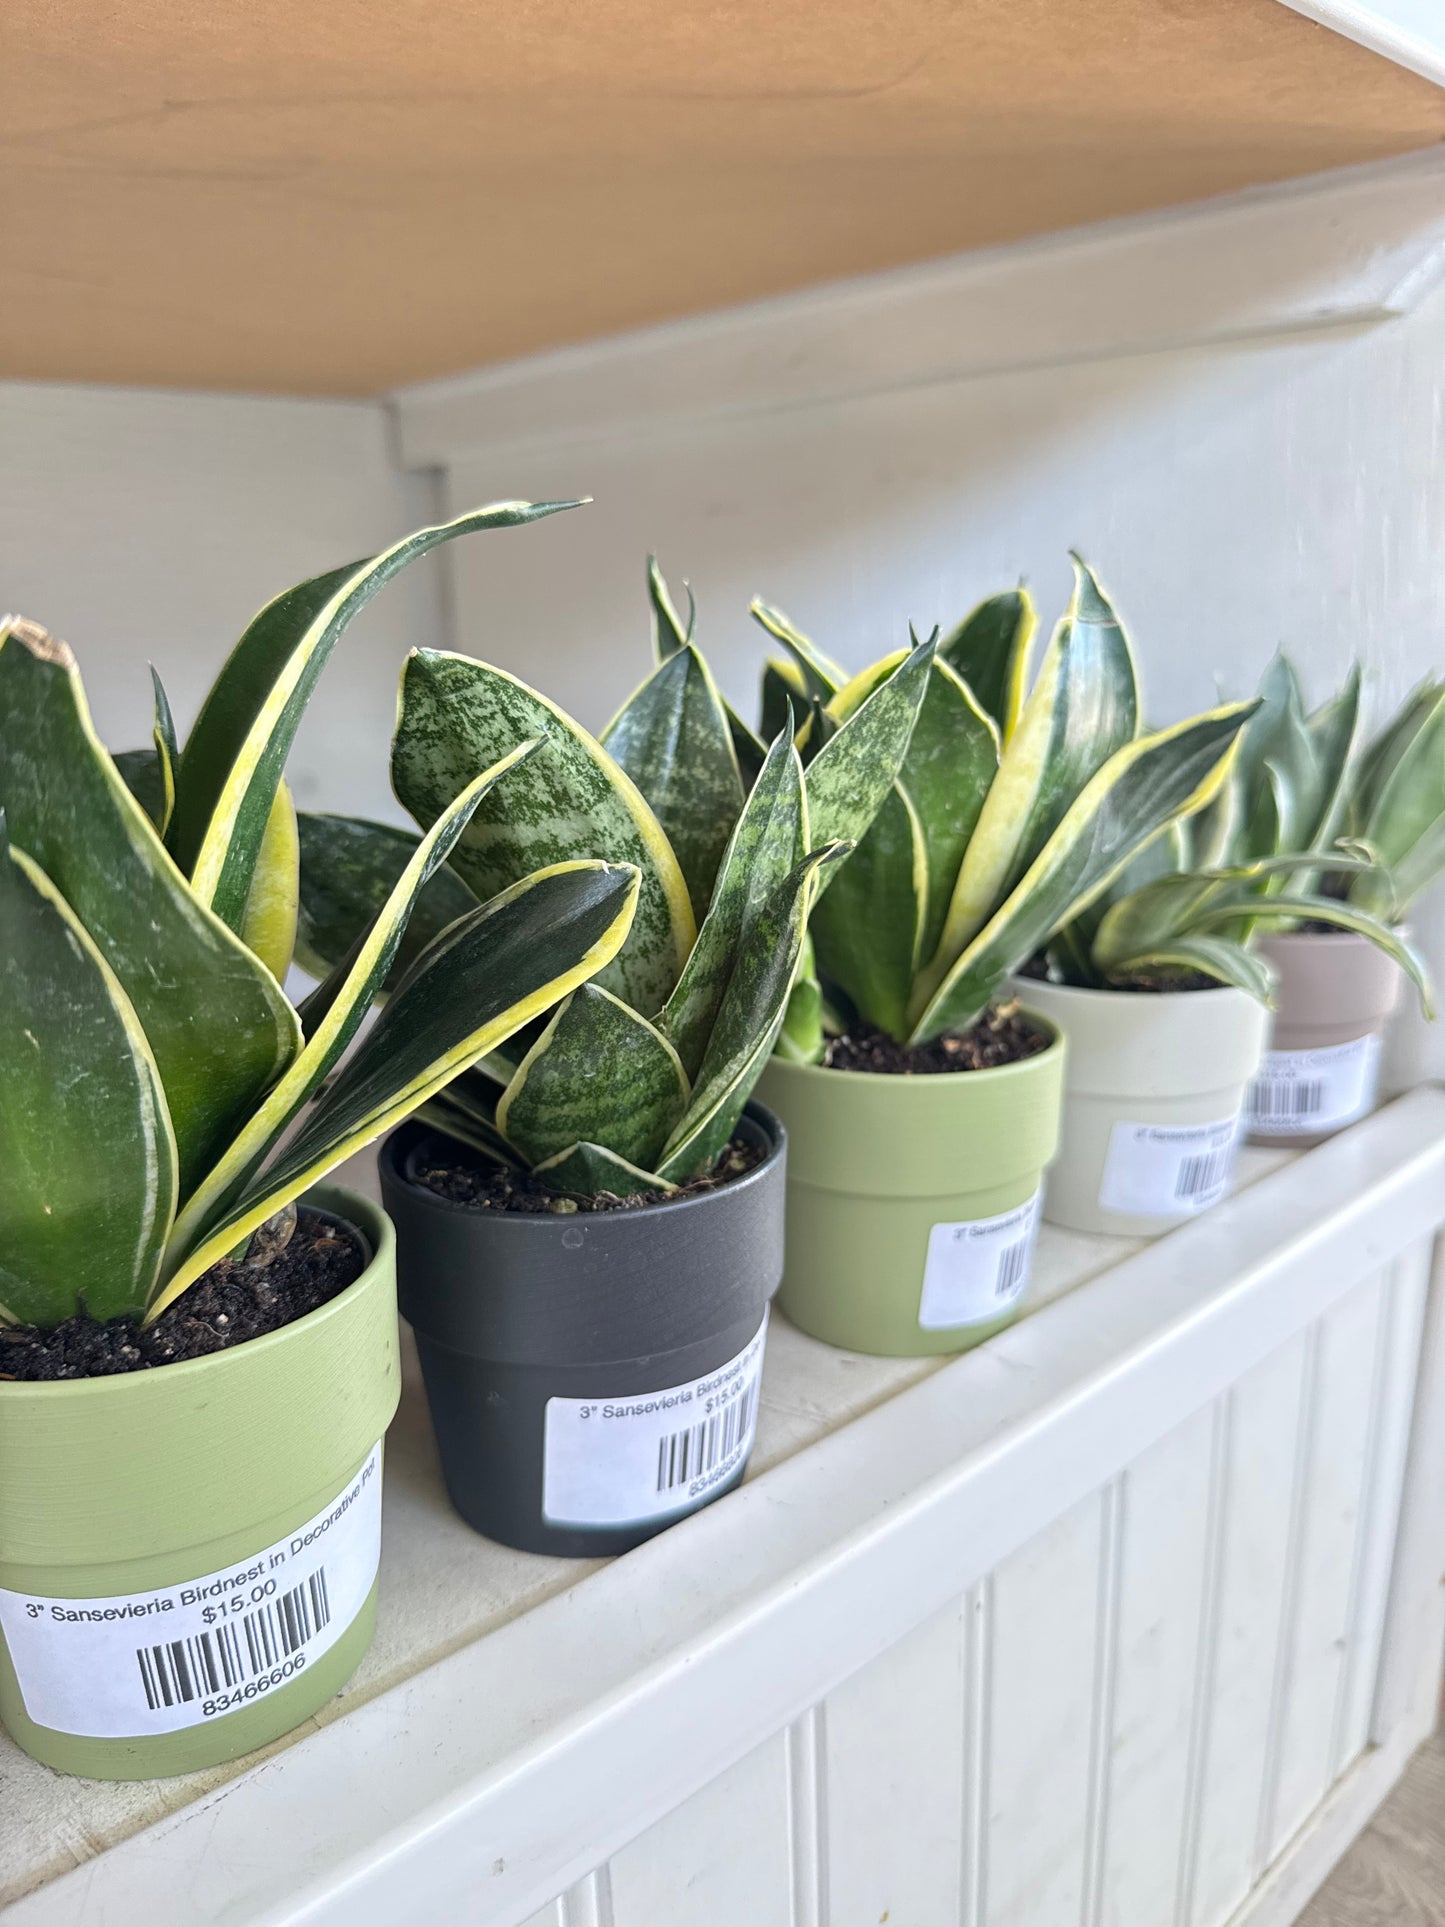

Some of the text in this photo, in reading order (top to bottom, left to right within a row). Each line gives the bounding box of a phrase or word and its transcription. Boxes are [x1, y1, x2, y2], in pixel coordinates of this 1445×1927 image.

[602, 1389, 693, 1419] Sansevieria
[705, 1375, 745, 1414] $15.00
[50, 1598, 174, 1623] Sansevieria
[180, 1563, 265, 1606] Birdnest
[269, 1551, 286, 1571] in
[290, 1484, 361, 1557] Decorative
[201, 1578, 278, 1625] $15.00
[202, 1652, 307, 1717] 83466606
